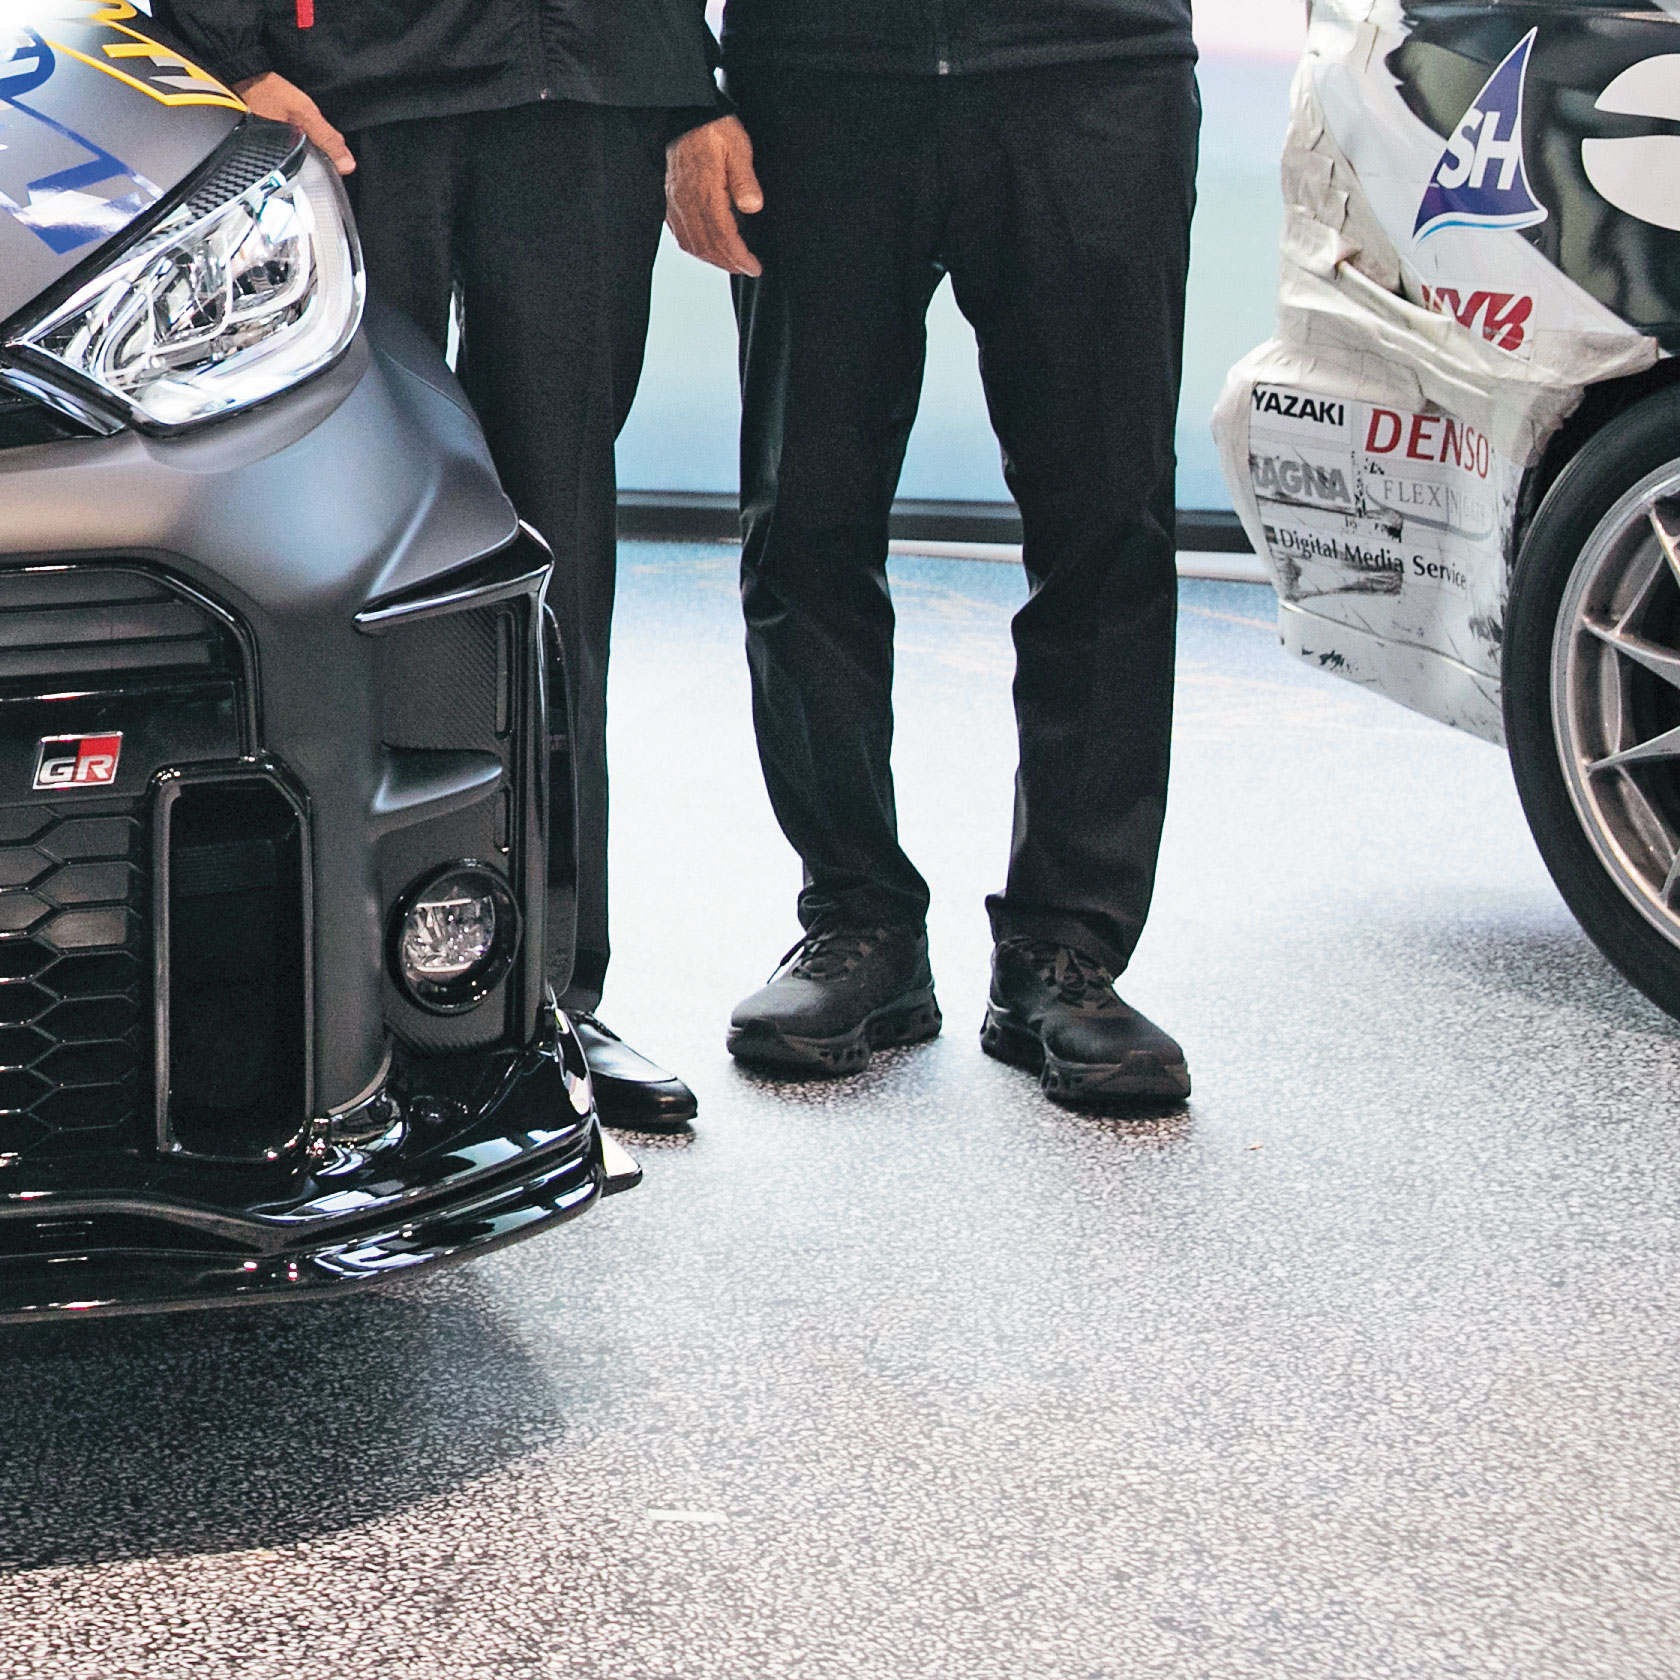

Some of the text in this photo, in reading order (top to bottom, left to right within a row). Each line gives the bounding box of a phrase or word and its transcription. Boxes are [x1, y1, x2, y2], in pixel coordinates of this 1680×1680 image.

[1252, 388, 1345, 427] YAZAKI
[1364, 407, 1489, 480] DENSO
[1280, 528, 1339, 560] Digital
[1343, 542, 1405, 574] Media
[1412, 554, 1468, 591] Service
[39, 753, 114, 784] GR
